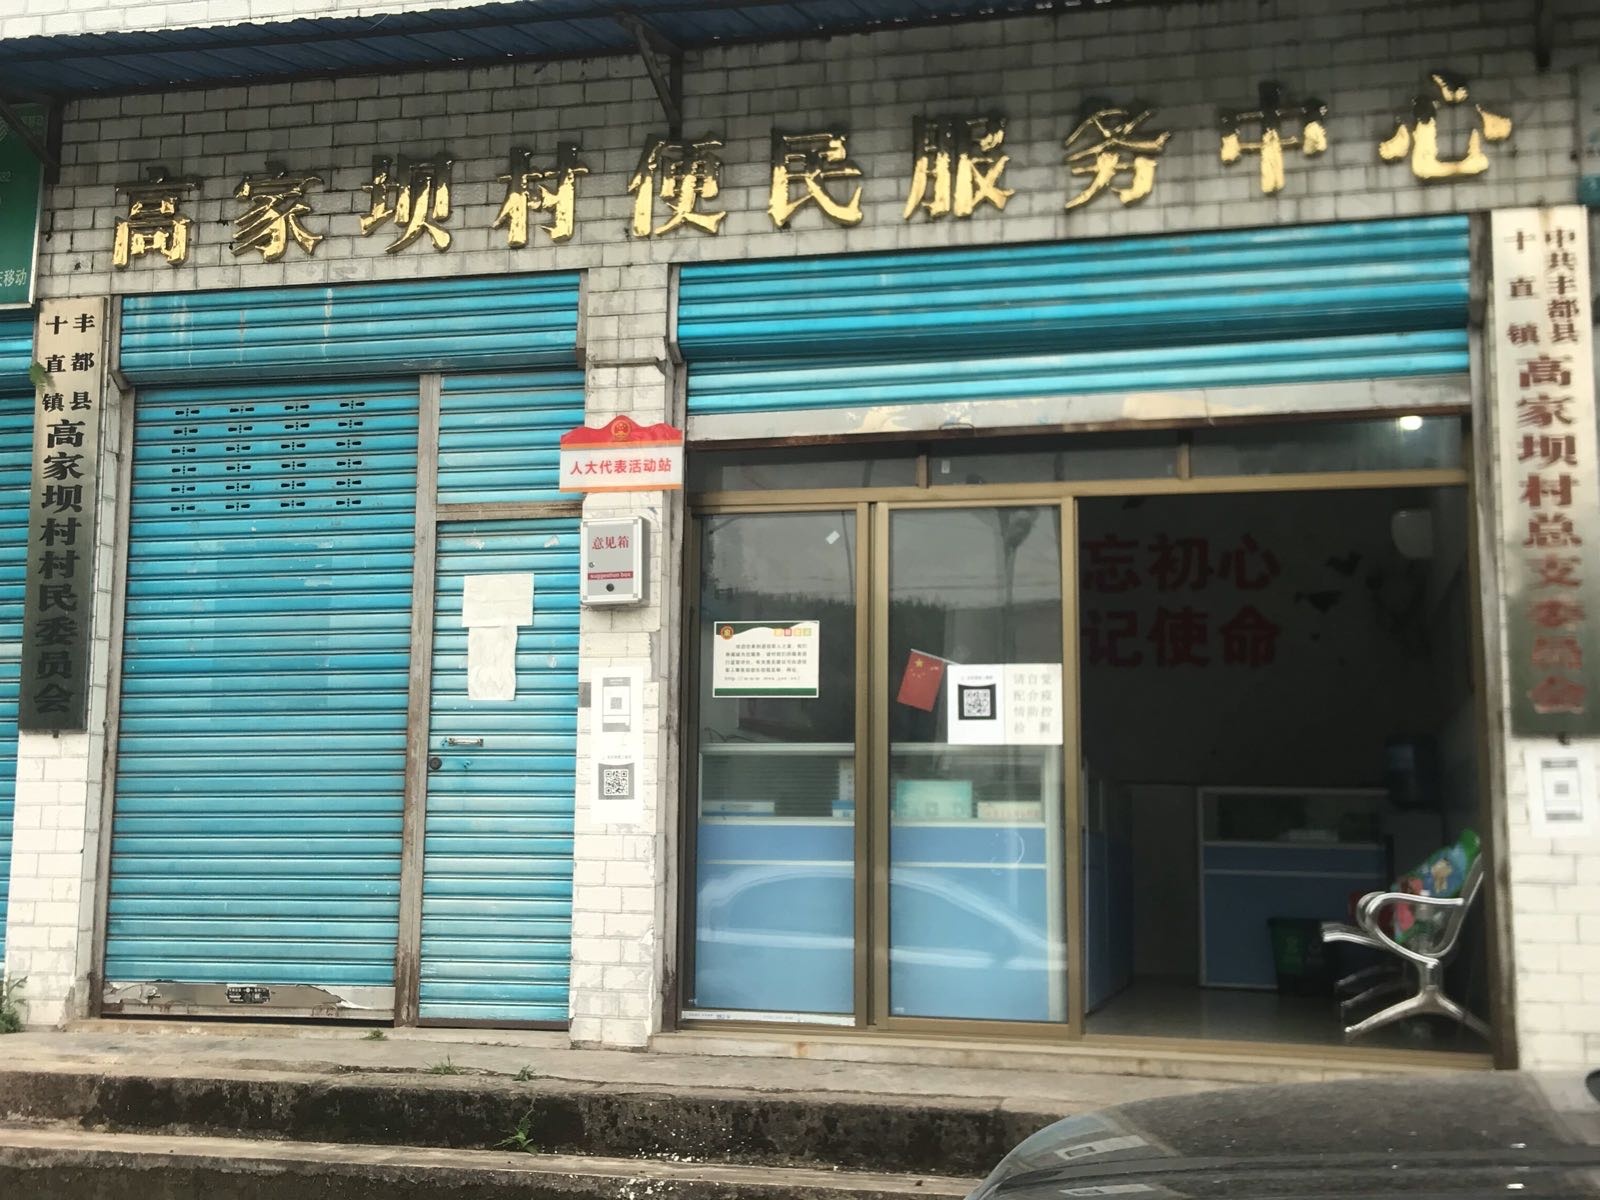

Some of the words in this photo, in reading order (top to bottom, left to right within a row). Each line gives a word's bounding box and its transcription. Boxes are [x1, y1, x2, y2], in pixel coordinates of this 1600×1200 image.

[112, 73, 1513, 269] 高家坝村便民服务中心
[0, 267, 27, 287] 移动
[1504, 230, 1540, 345] 十直镇
[1544, 229, 1579, 342] 中共丰都县
[42, 314, 69, 414] 十直镇
[69, 312, 96, 412] 丰都县
[570, 458, 672, 475] 人大代表活动站
[33, 419, 85, 715] 高家坝村村民委员会
[592, 535, 630, 550] 意见箱
[1081, 532, 1284, 593] 忘初心
[1081, 605, 1285, 668] 记使命
